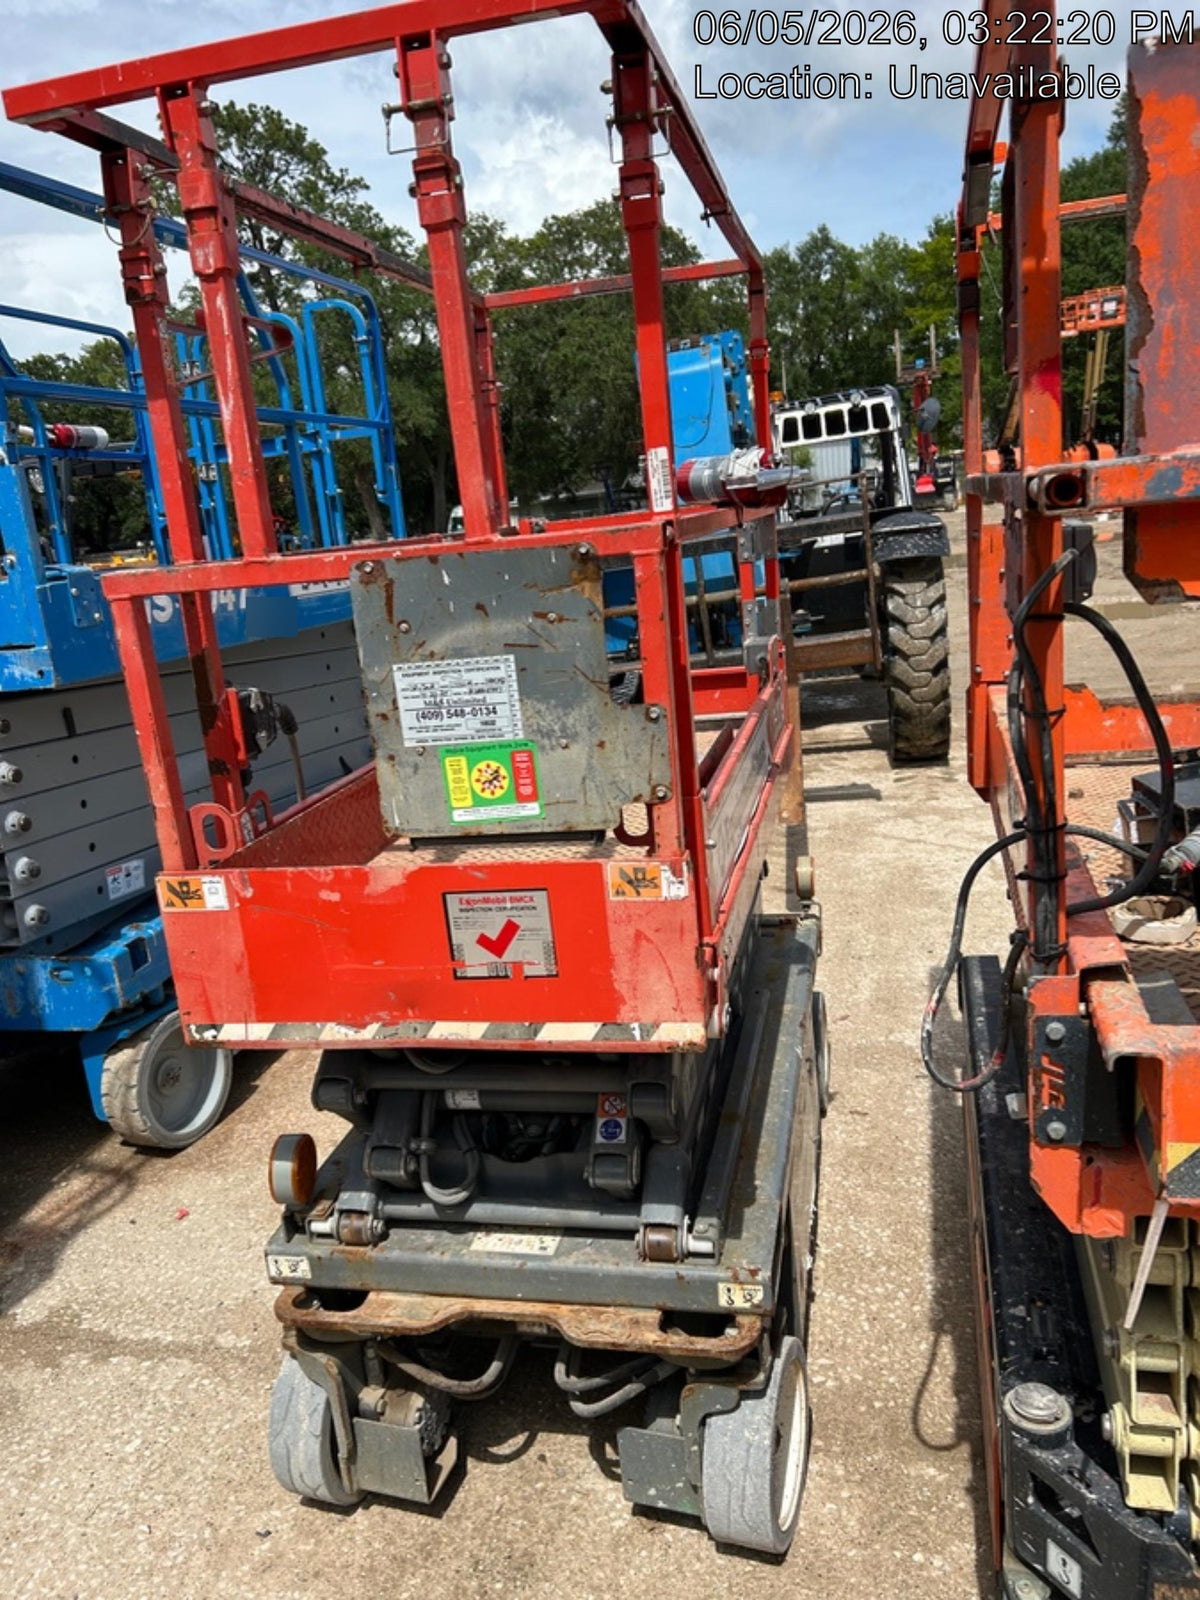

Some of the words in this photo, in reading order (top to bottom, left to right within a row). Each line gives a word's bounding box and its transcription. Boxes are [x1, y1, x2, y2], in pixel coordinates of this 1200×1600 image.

[415, 710, 444, 723] (409)
[446, 706, 498, 719] 548-0134
[1041, 1053, 1065, 1111] JLG
